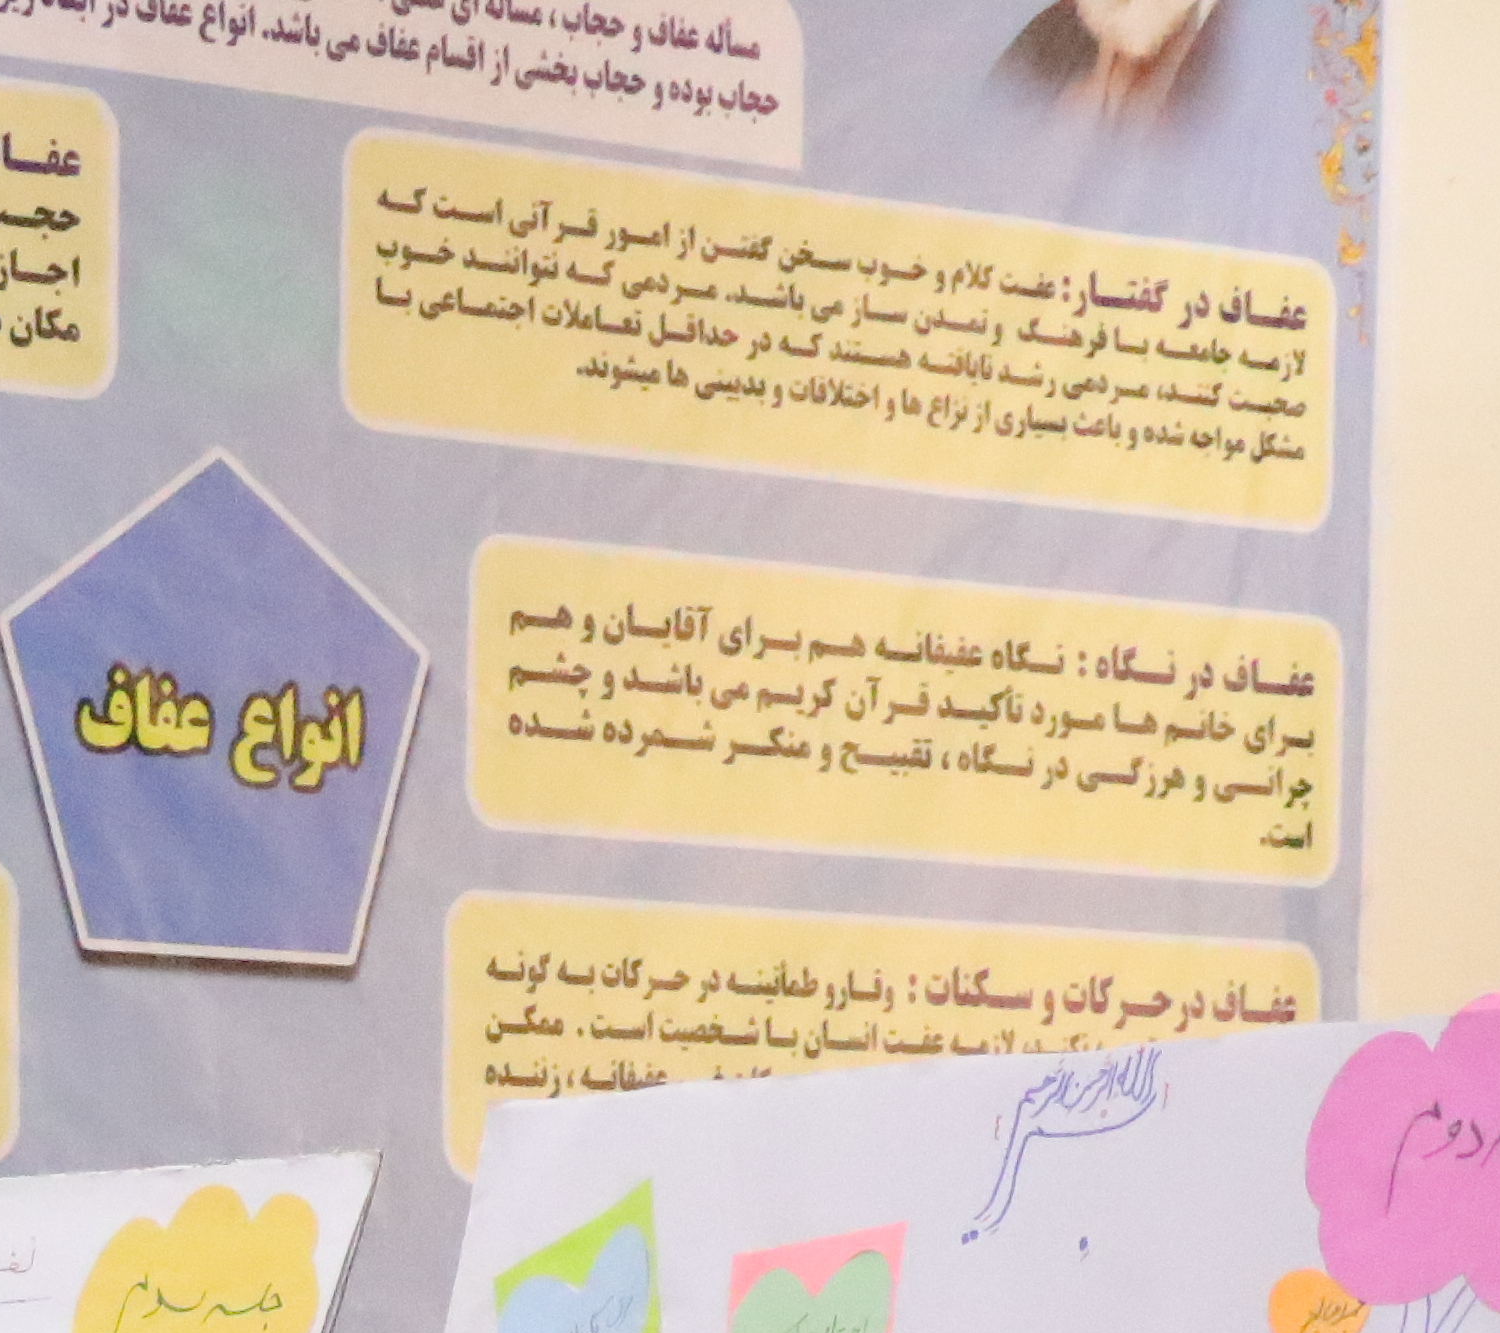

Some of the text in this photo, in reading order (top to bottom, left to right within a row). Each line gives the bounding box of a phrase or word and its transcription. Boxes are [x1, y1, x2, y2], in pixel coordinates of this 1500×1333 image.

[8, 305, 81, 349] مکان
[509, 603, 1315, 701] عفاف در نگاه نگاه عفیفانه هم برای آقایان و هم
[76, 664, 363, 790] انواع عفاف
[1386, 1104, 1485, 1217] دوم
[202, 1282, 283, 1332] جلسه
